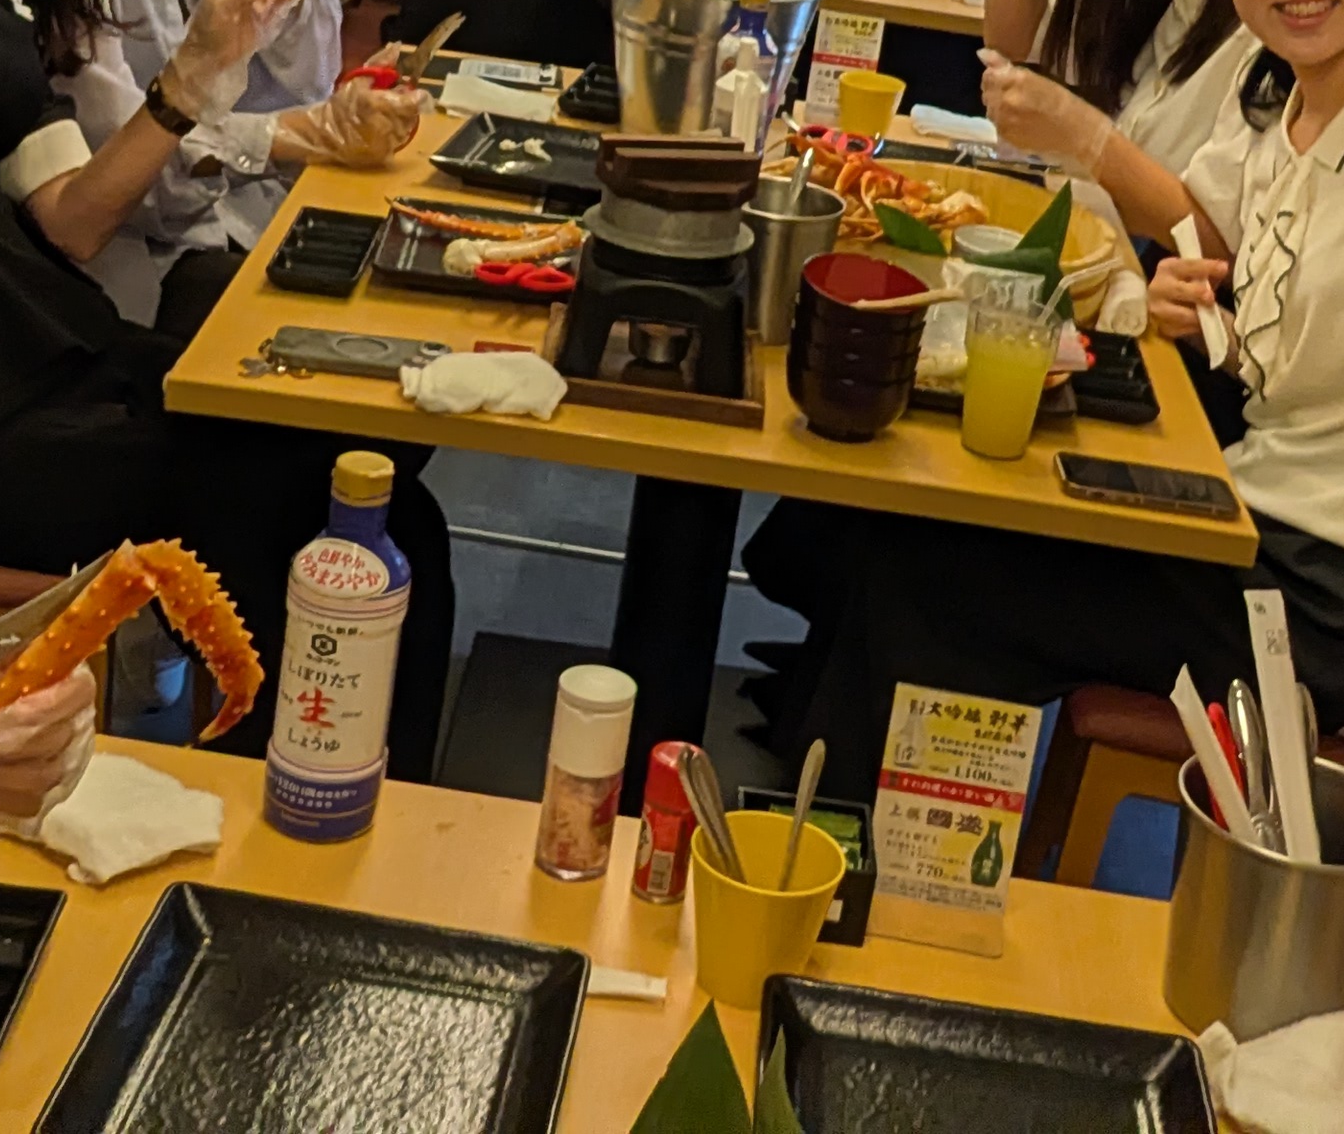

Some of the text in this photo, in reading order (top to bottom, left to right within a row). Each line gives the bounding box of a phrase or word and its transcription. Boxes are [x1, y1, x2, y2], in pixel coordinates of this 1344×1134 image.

[288, 659, 361, 689] しぼりたて
[296, 686, 337, 728] 生
[287, 727, 341, 753] しょうゆ
